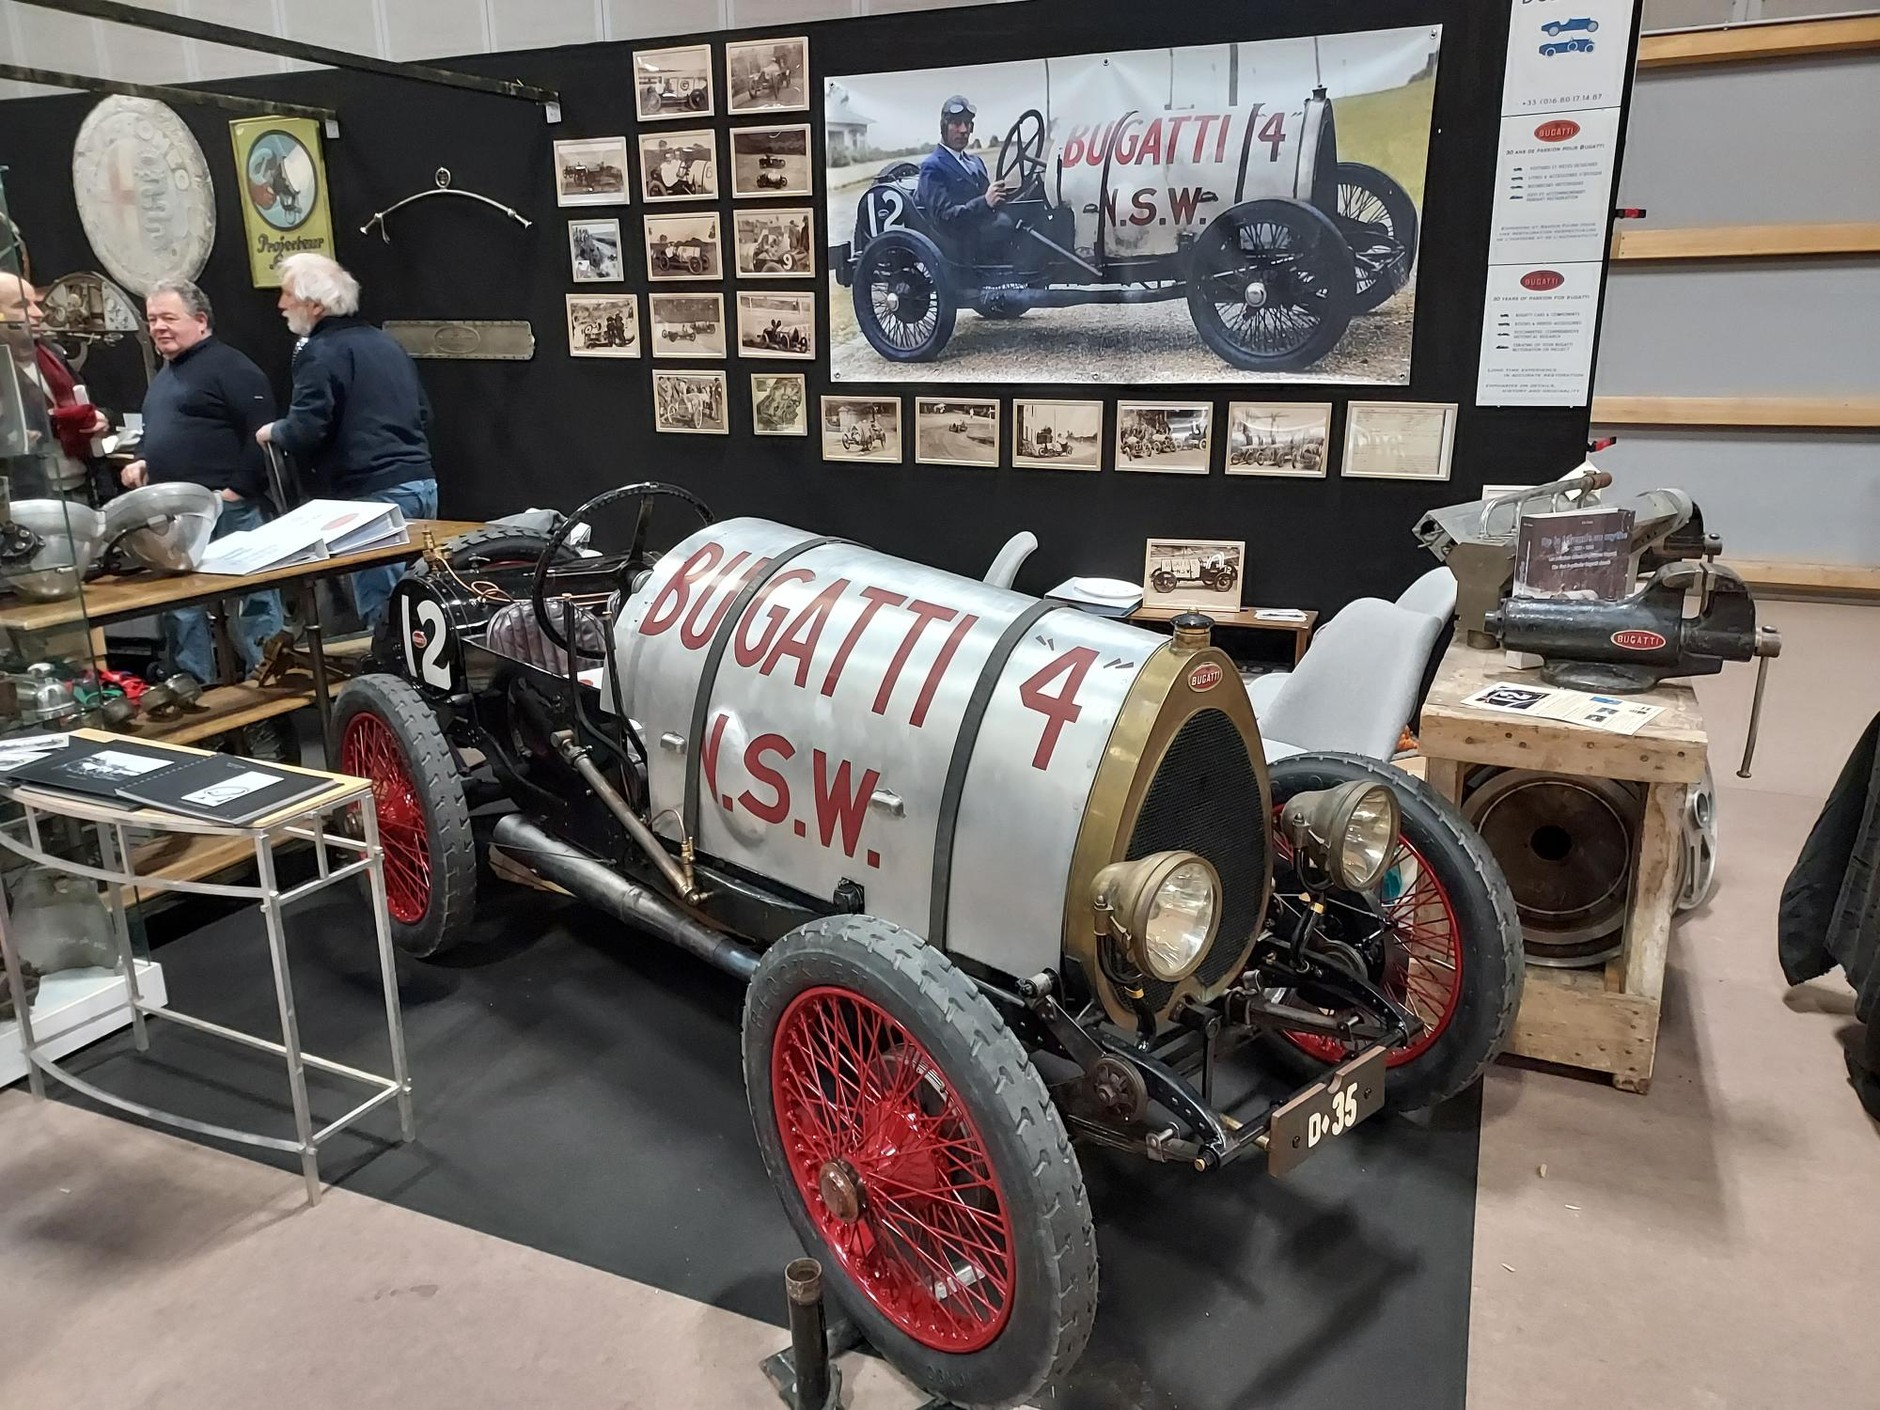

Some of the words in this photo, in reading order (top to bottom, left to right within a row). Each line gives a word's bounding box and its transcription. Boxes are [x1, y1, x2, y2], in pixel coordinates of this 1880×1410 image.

[1539, 128, 1574, 137] BUGATTI
[1062, 114, 1231, 168] BUGATTI
[867, 190, 904, 237] 12
[783, 254, 793, 270] 9
[1524, 278, 1559, 286] BUGATTI
[401, 594, 452, 691] 12
[638, 541, 979, 728] BUGATTI
[1617, 635, 1659, 646] BUGATTI
[1191, 672, 1220, 686] BUGATTI
